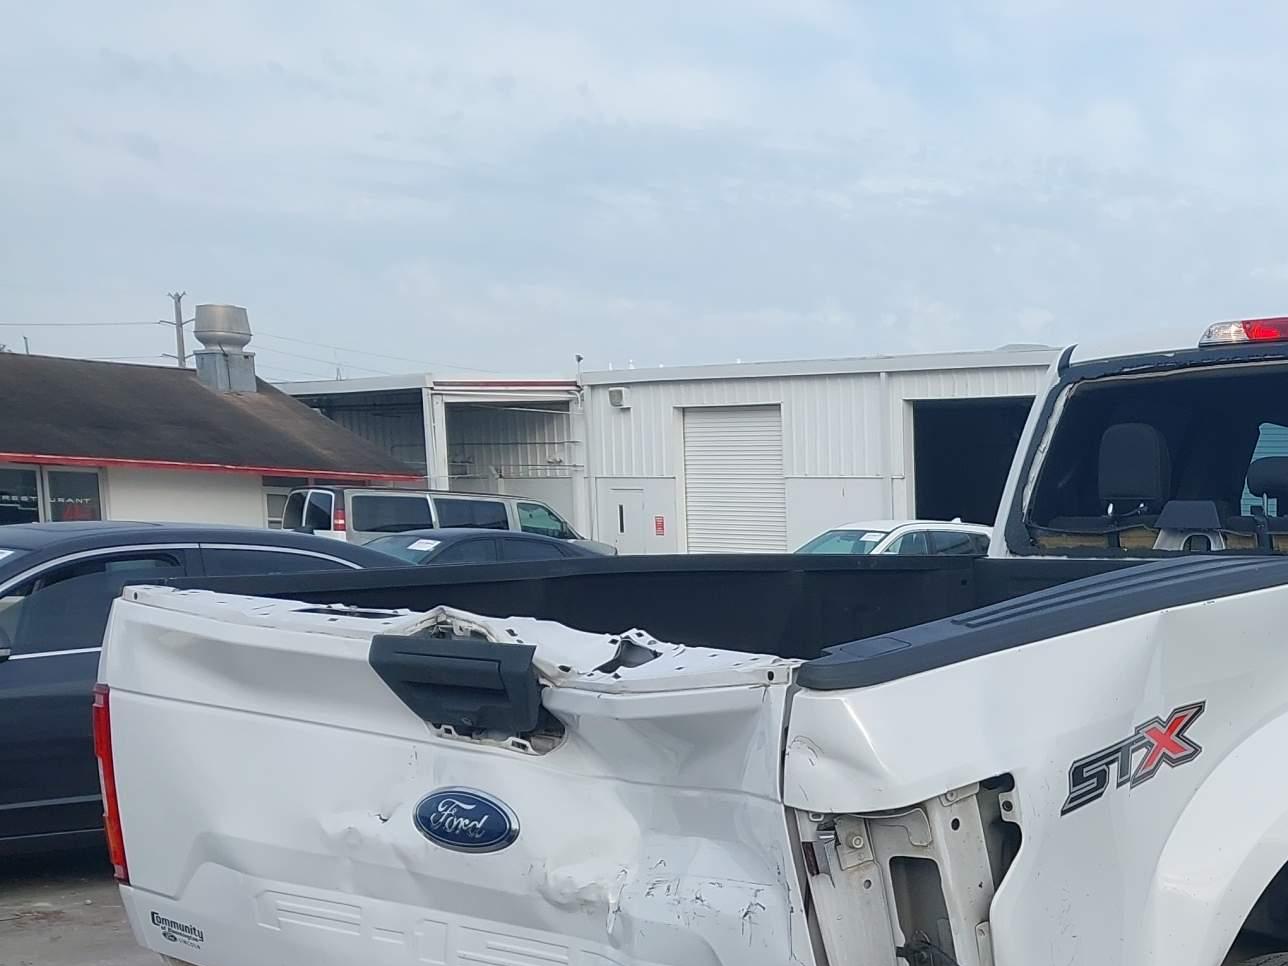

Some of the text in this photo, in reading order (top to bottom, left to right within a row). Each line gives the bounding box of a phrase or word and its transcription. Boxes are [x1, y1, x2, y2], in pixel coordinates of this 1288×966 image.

[1, 495, 91, 504] RESTURANT
[1060, 700, 1206, 817] STX
[151, 911, 204, 942] Community
